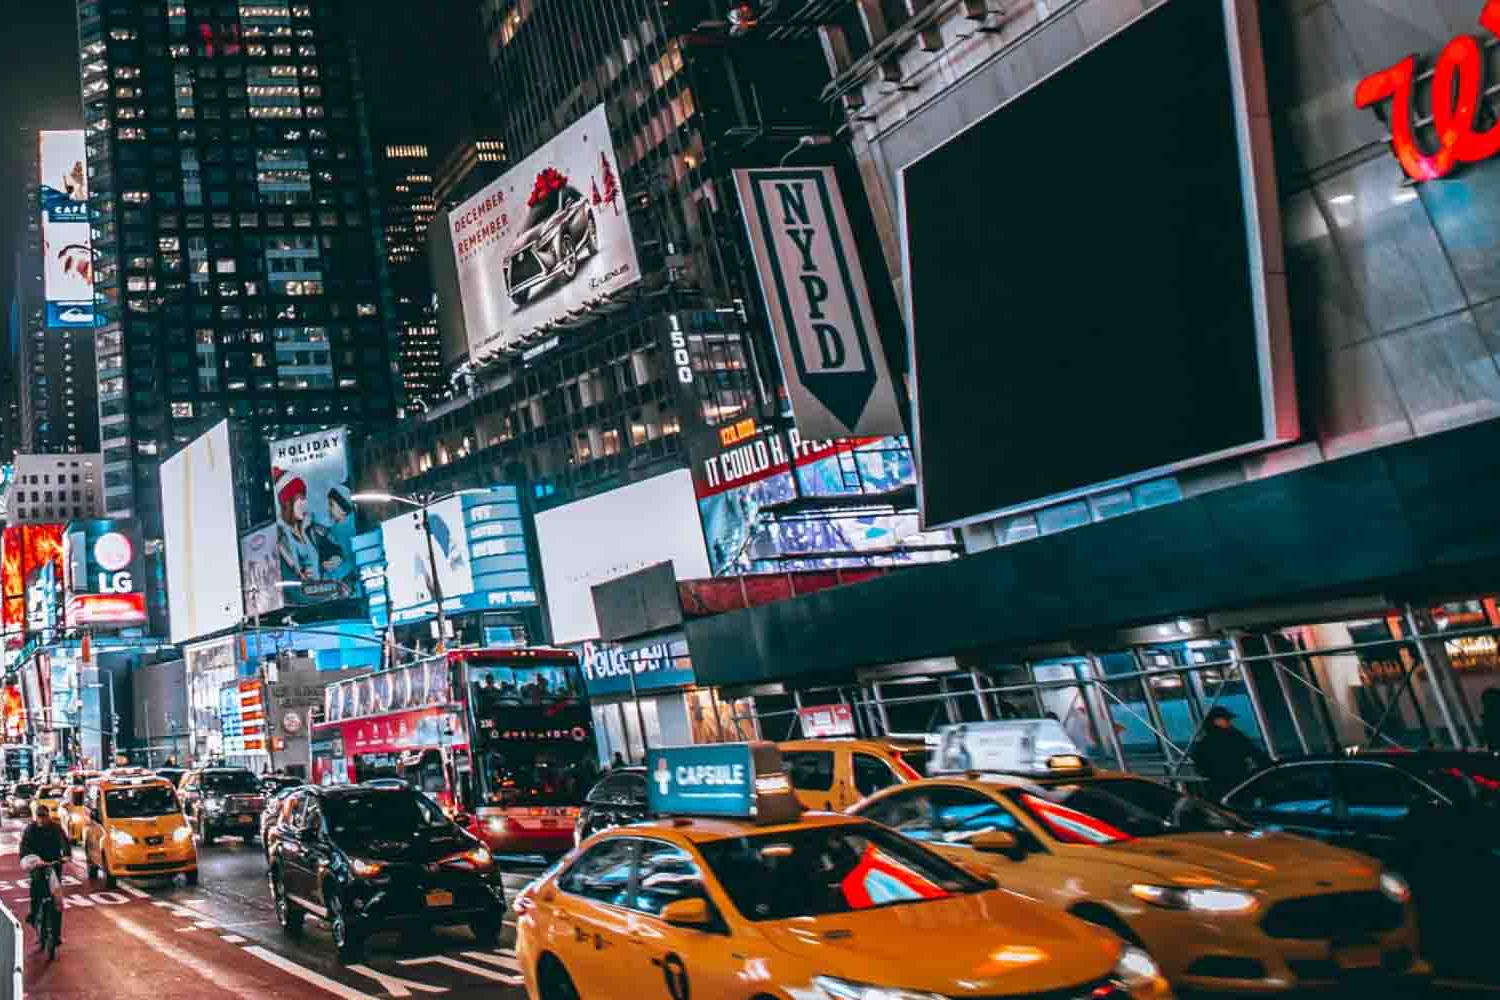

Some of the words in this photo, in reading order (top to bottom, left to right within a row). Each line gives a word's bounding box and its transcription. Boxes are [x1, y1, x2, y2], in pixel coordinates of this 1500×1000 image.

[454, 190, 505, 233] DECEMBER
[457, 213, 509, 256] REMEMBER
[775, 182, 846, 369] NYPD
[669, 314, 693, 384] 1500
[278, 436, 339, 458] HOLIDAY
[705, 457, 721, 488] IT
[720, 440, 770, 482] COULD
[98, 571, 132, 593] LG
[676, 764, 745, 786] CAPSULE
